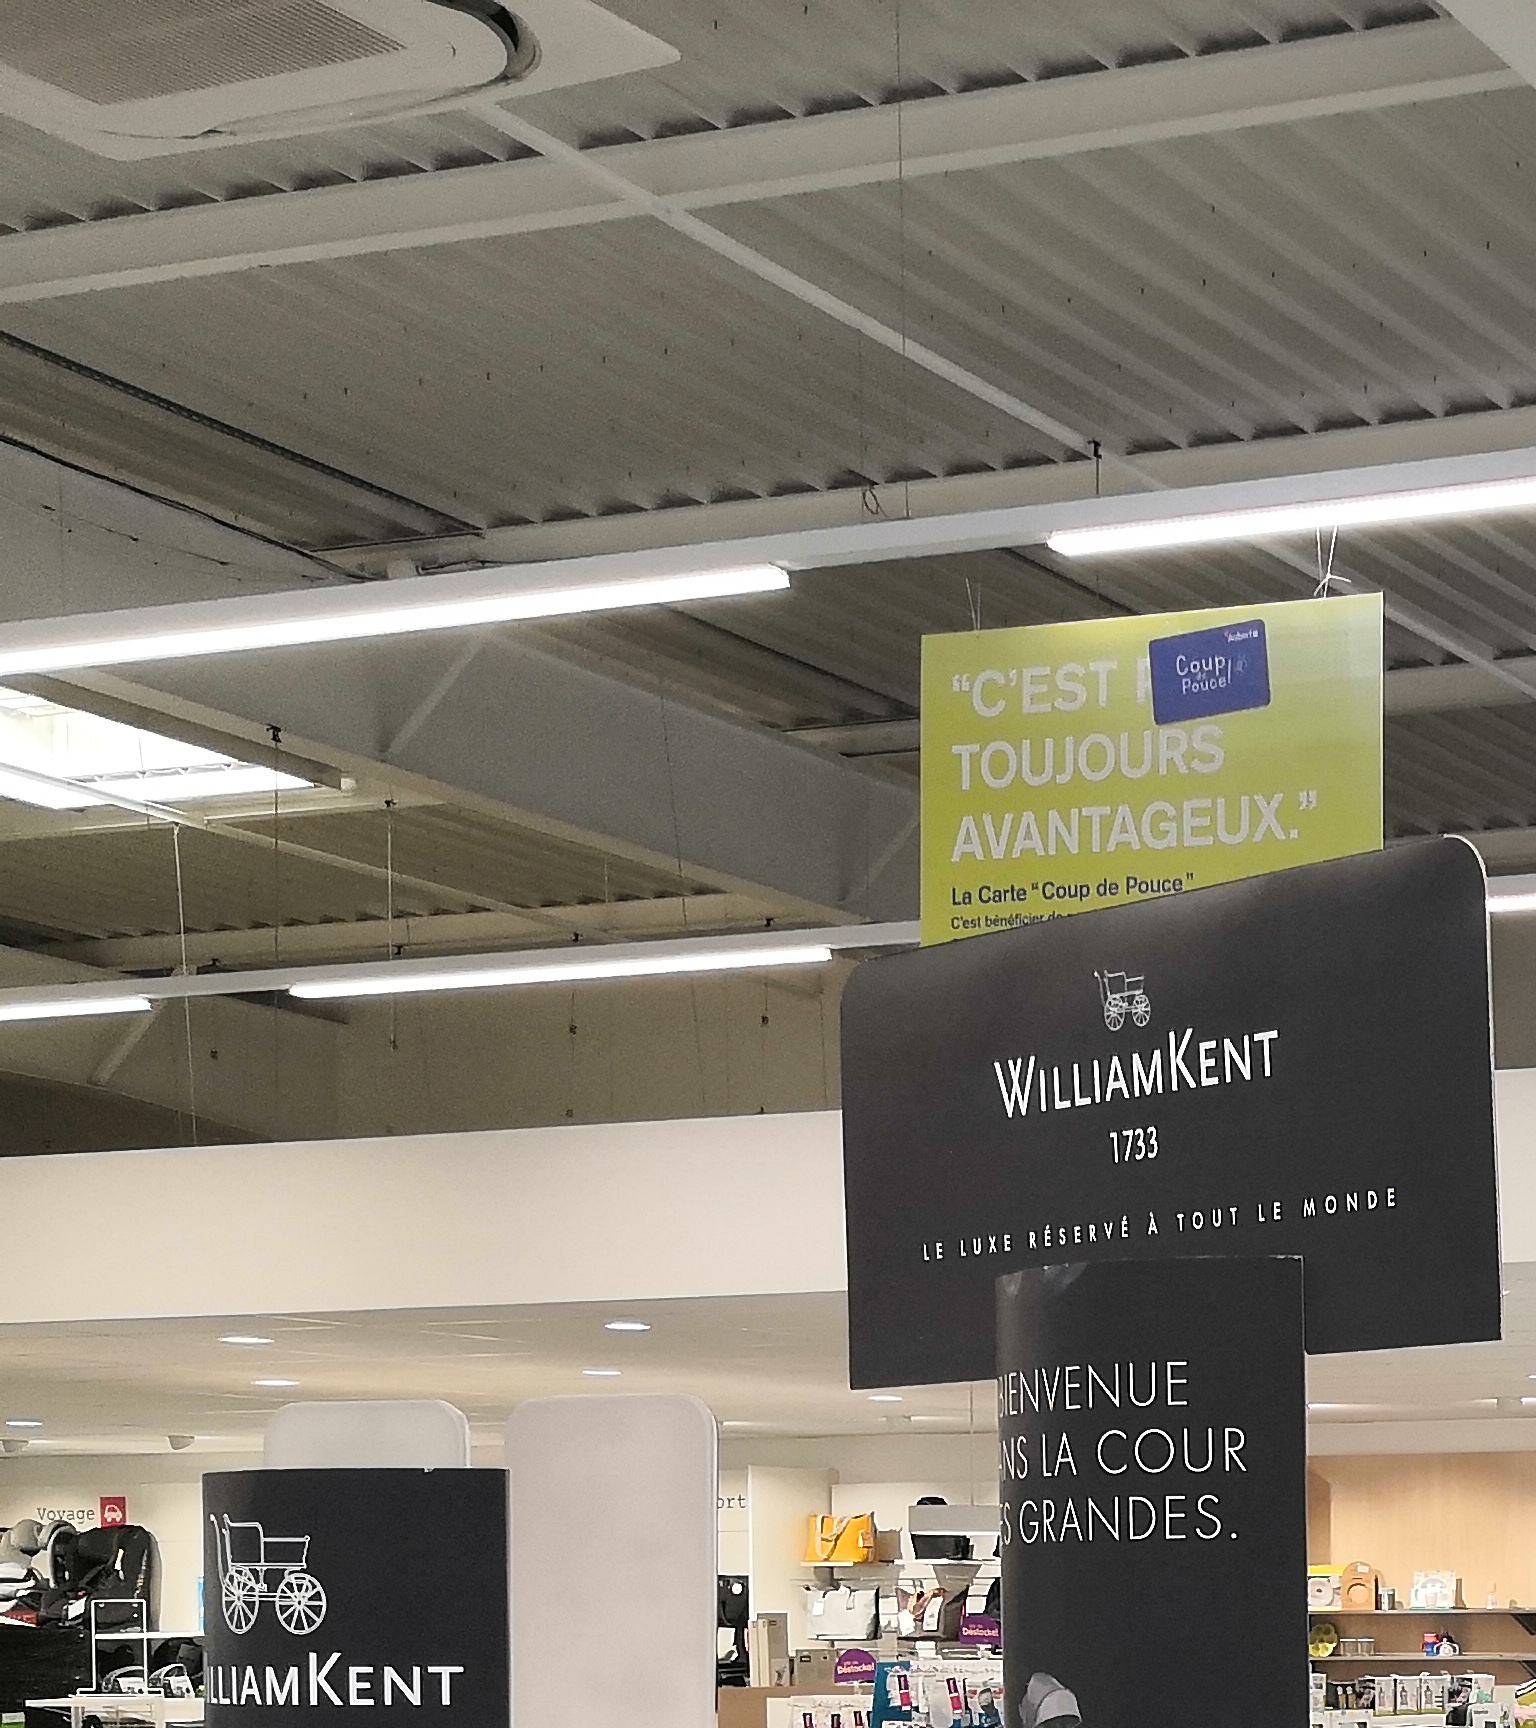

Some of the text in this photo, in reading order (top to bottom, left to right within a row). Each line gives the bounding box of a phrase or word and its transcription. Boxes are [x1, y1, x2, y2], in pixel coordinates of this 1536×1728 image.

[1176, 655, 1225, 676] Coup
[1182, 676, 1227, 694] Pouce
[951, 725, 1225, 790] TOUJOURS
[951, 886, 972, 906] La
[978, 883, 1028, 904] Carte
[1096, 878, 1119, 897] de
[1109, 1126, 1159, 1164] 1733
[922, 1187, 1397, 1261] LE LUXE RÉSERVÉ À TOUT LE MONDE
[1041, 1432, 1078, 1477] LA
[1097, 1427, 1248, 1475] COUR
[1019, 1494, 1238, 1544] GRANDES.
